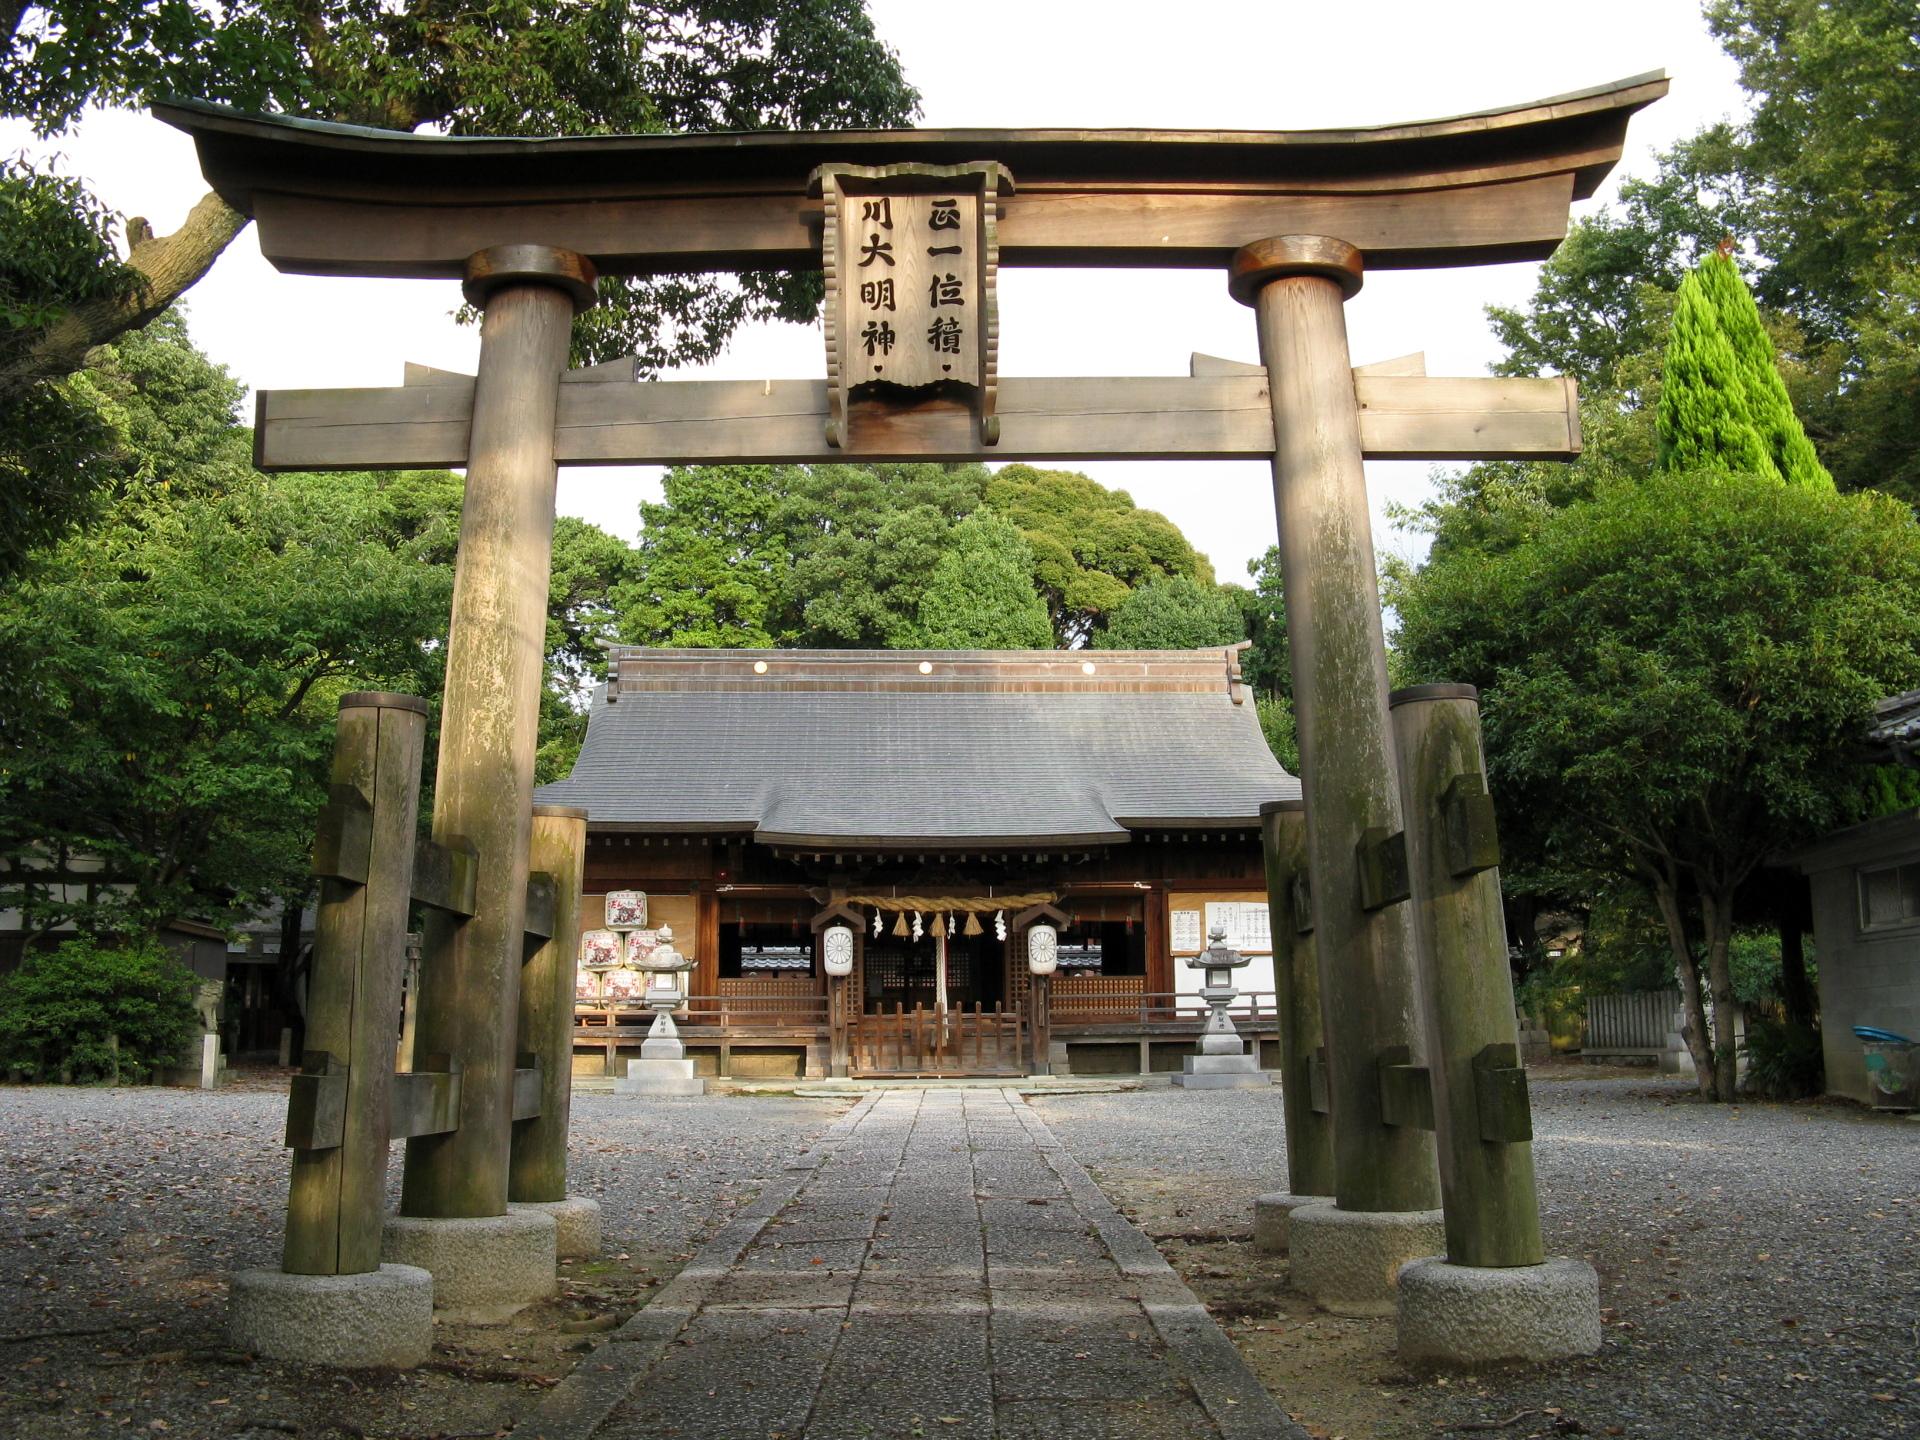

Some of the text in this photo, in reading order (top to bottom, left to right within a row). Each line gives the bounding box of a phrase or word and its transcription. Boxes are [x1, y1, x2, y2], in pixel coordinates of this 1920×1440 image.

[857, 197, 897, 356] 川大明神
[926, 198, 965, 354] 正一位積
